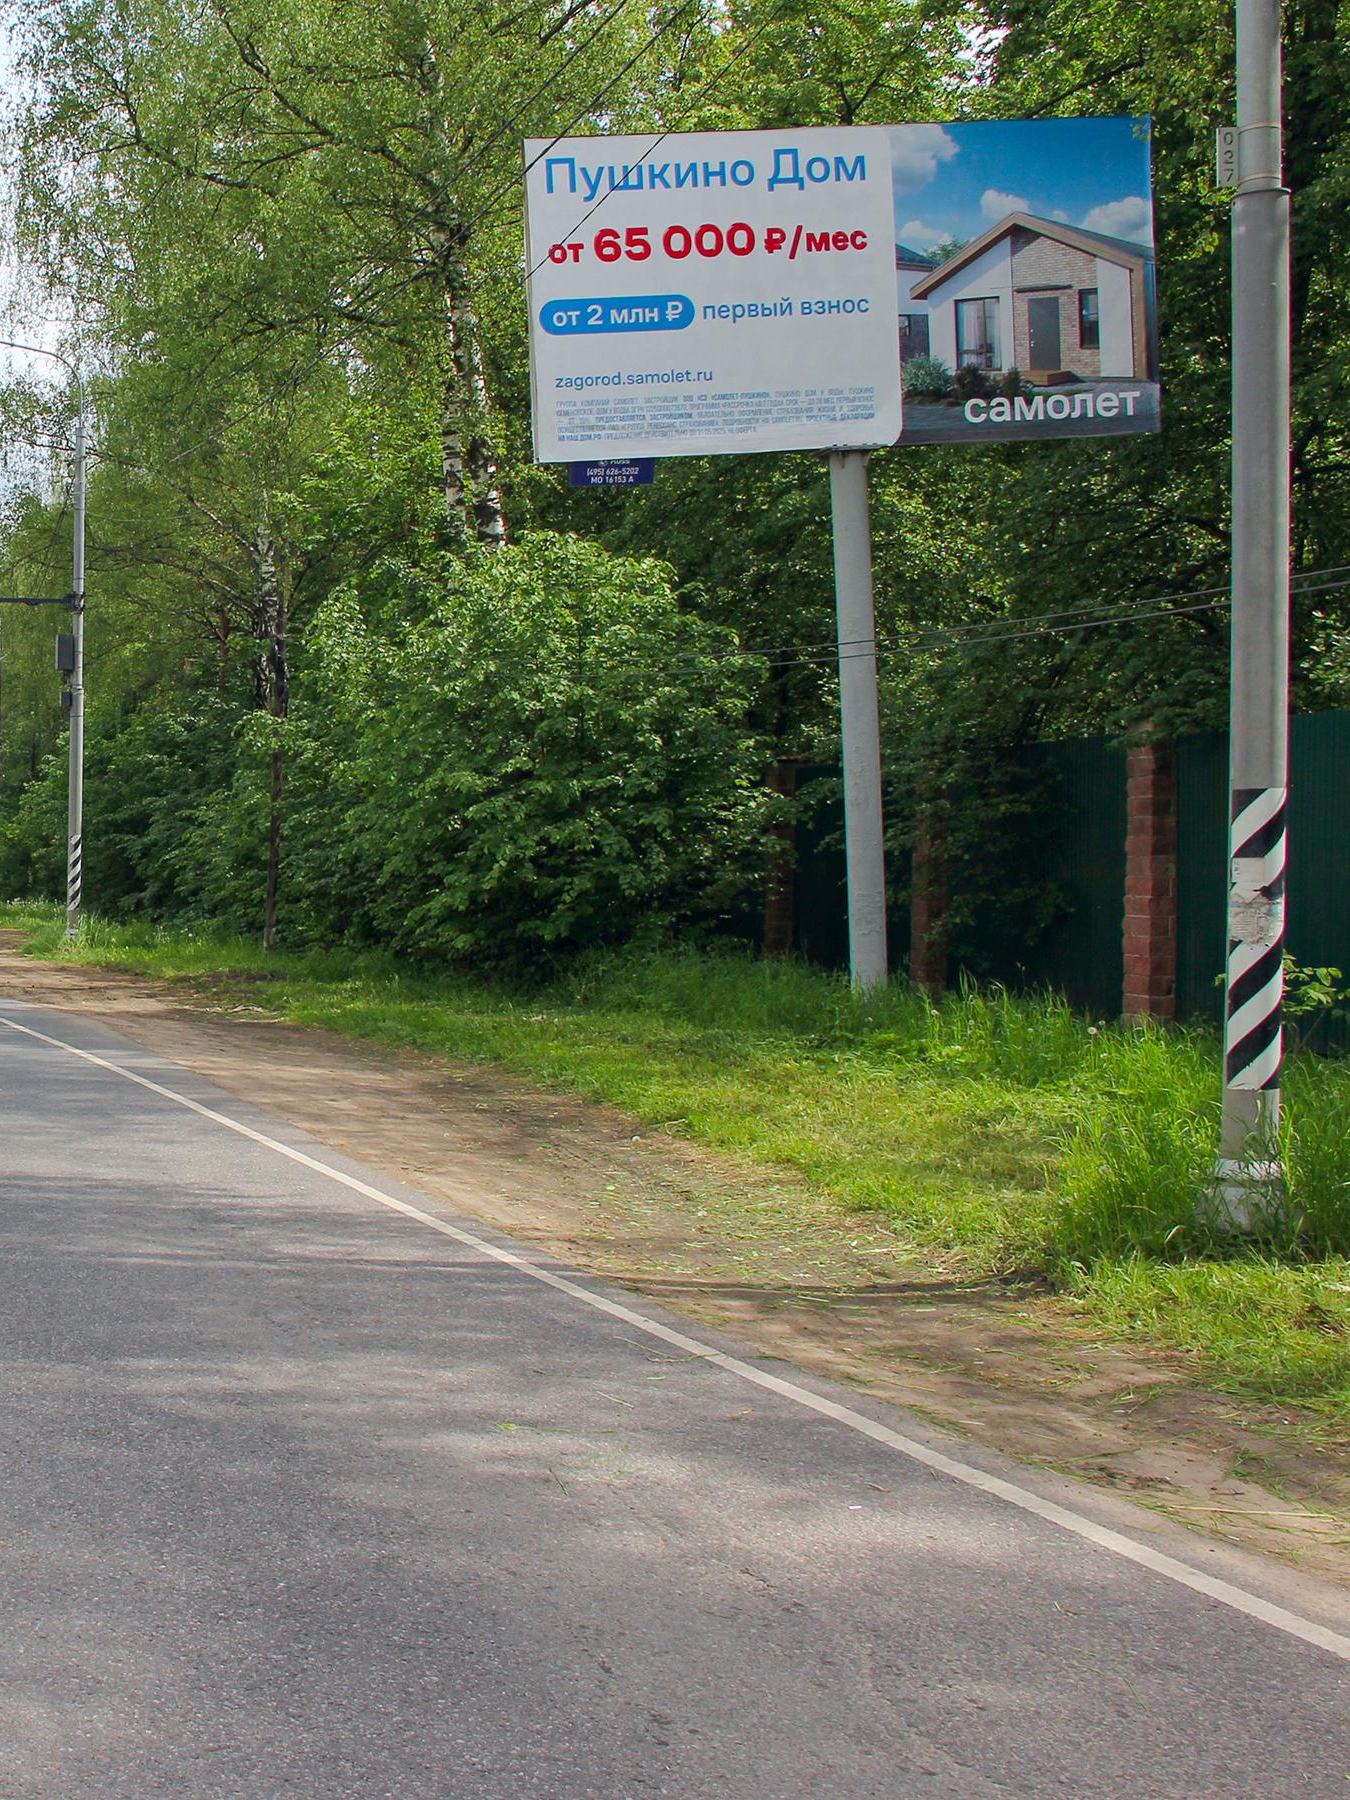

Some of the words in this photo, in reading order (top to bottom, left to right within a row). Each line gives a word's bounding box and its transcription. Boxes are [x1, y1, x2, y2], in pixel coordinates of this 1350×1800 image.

[545, 157, 755, 202] Пушкино
[767, 148, 866, 192] Дом
[549, 243, 585, 264] от
[594, 227, 651, 262] 65
[663, 222, 755, 259] 000
[553, 310, 580, 327] от
[587, 304, 603, 325] 2
[610, 307, 659, 324] млн
[703, 297, 793, 324] первый
[801, 298, 870, 316] взнос
[555, 369, 713, 391] zagorod.samolet.ru
[964, 390, 1141, 424] самолет
[606, 467, 639, 476] 626-5202
